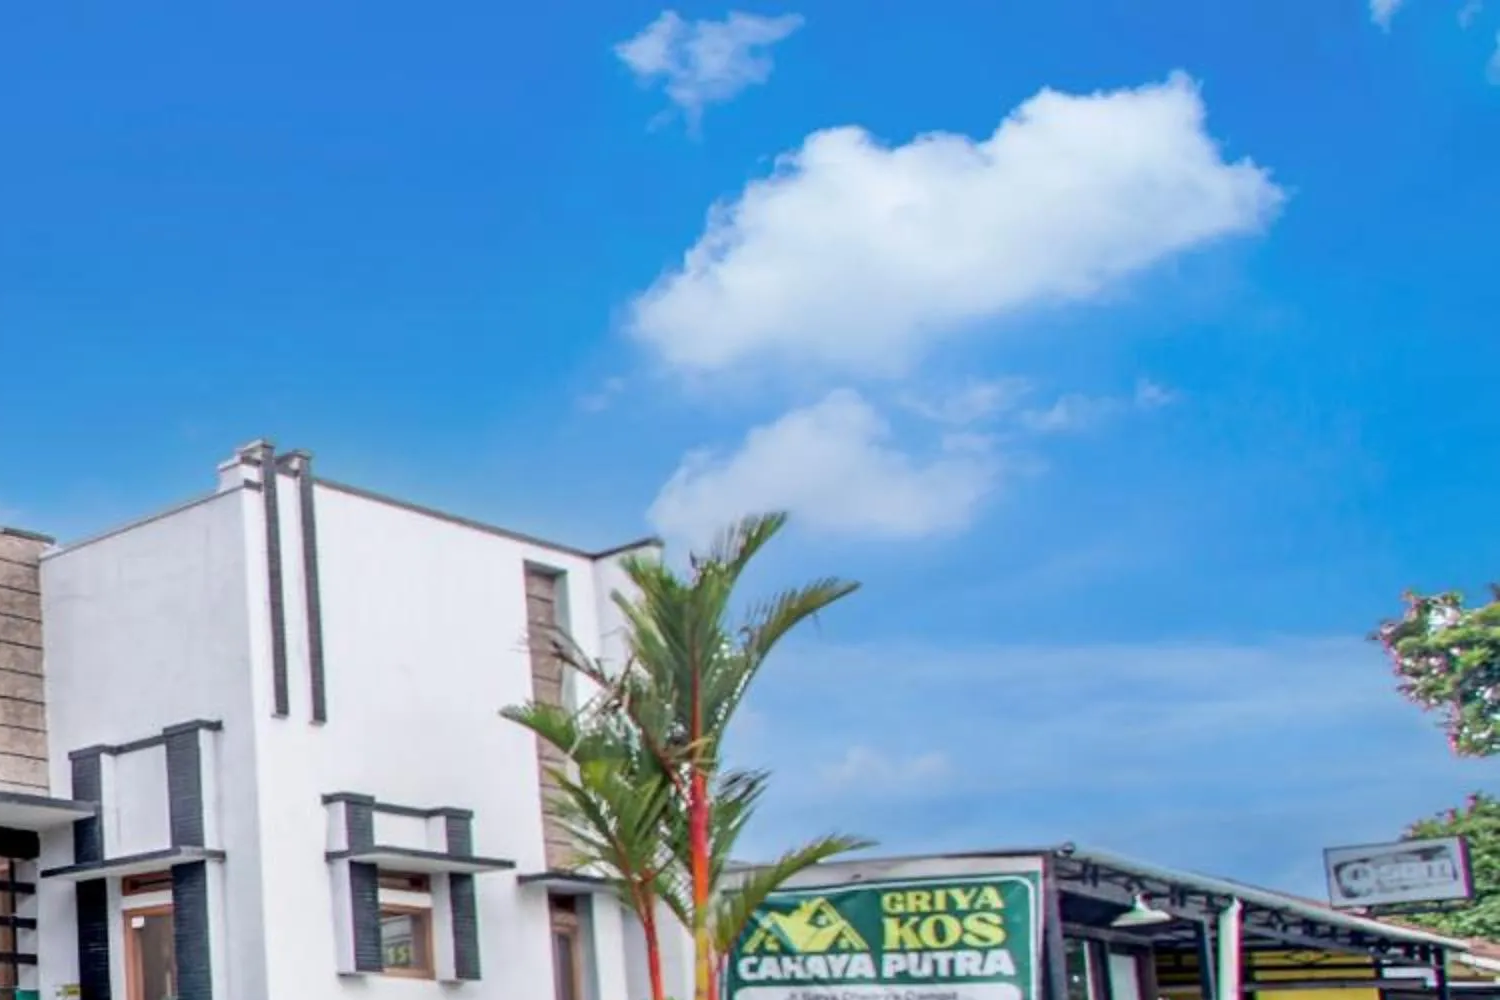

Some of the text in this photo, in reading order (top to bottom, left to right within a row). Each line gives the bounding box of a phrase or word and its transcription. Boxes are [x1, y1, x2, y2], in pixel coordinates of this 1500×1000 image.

[882, 887, 1004, 911] GRIYA
[883, 913, 1006, 949] KOS
[739, 950, 1015, 980] CAHAYA PUTRA
